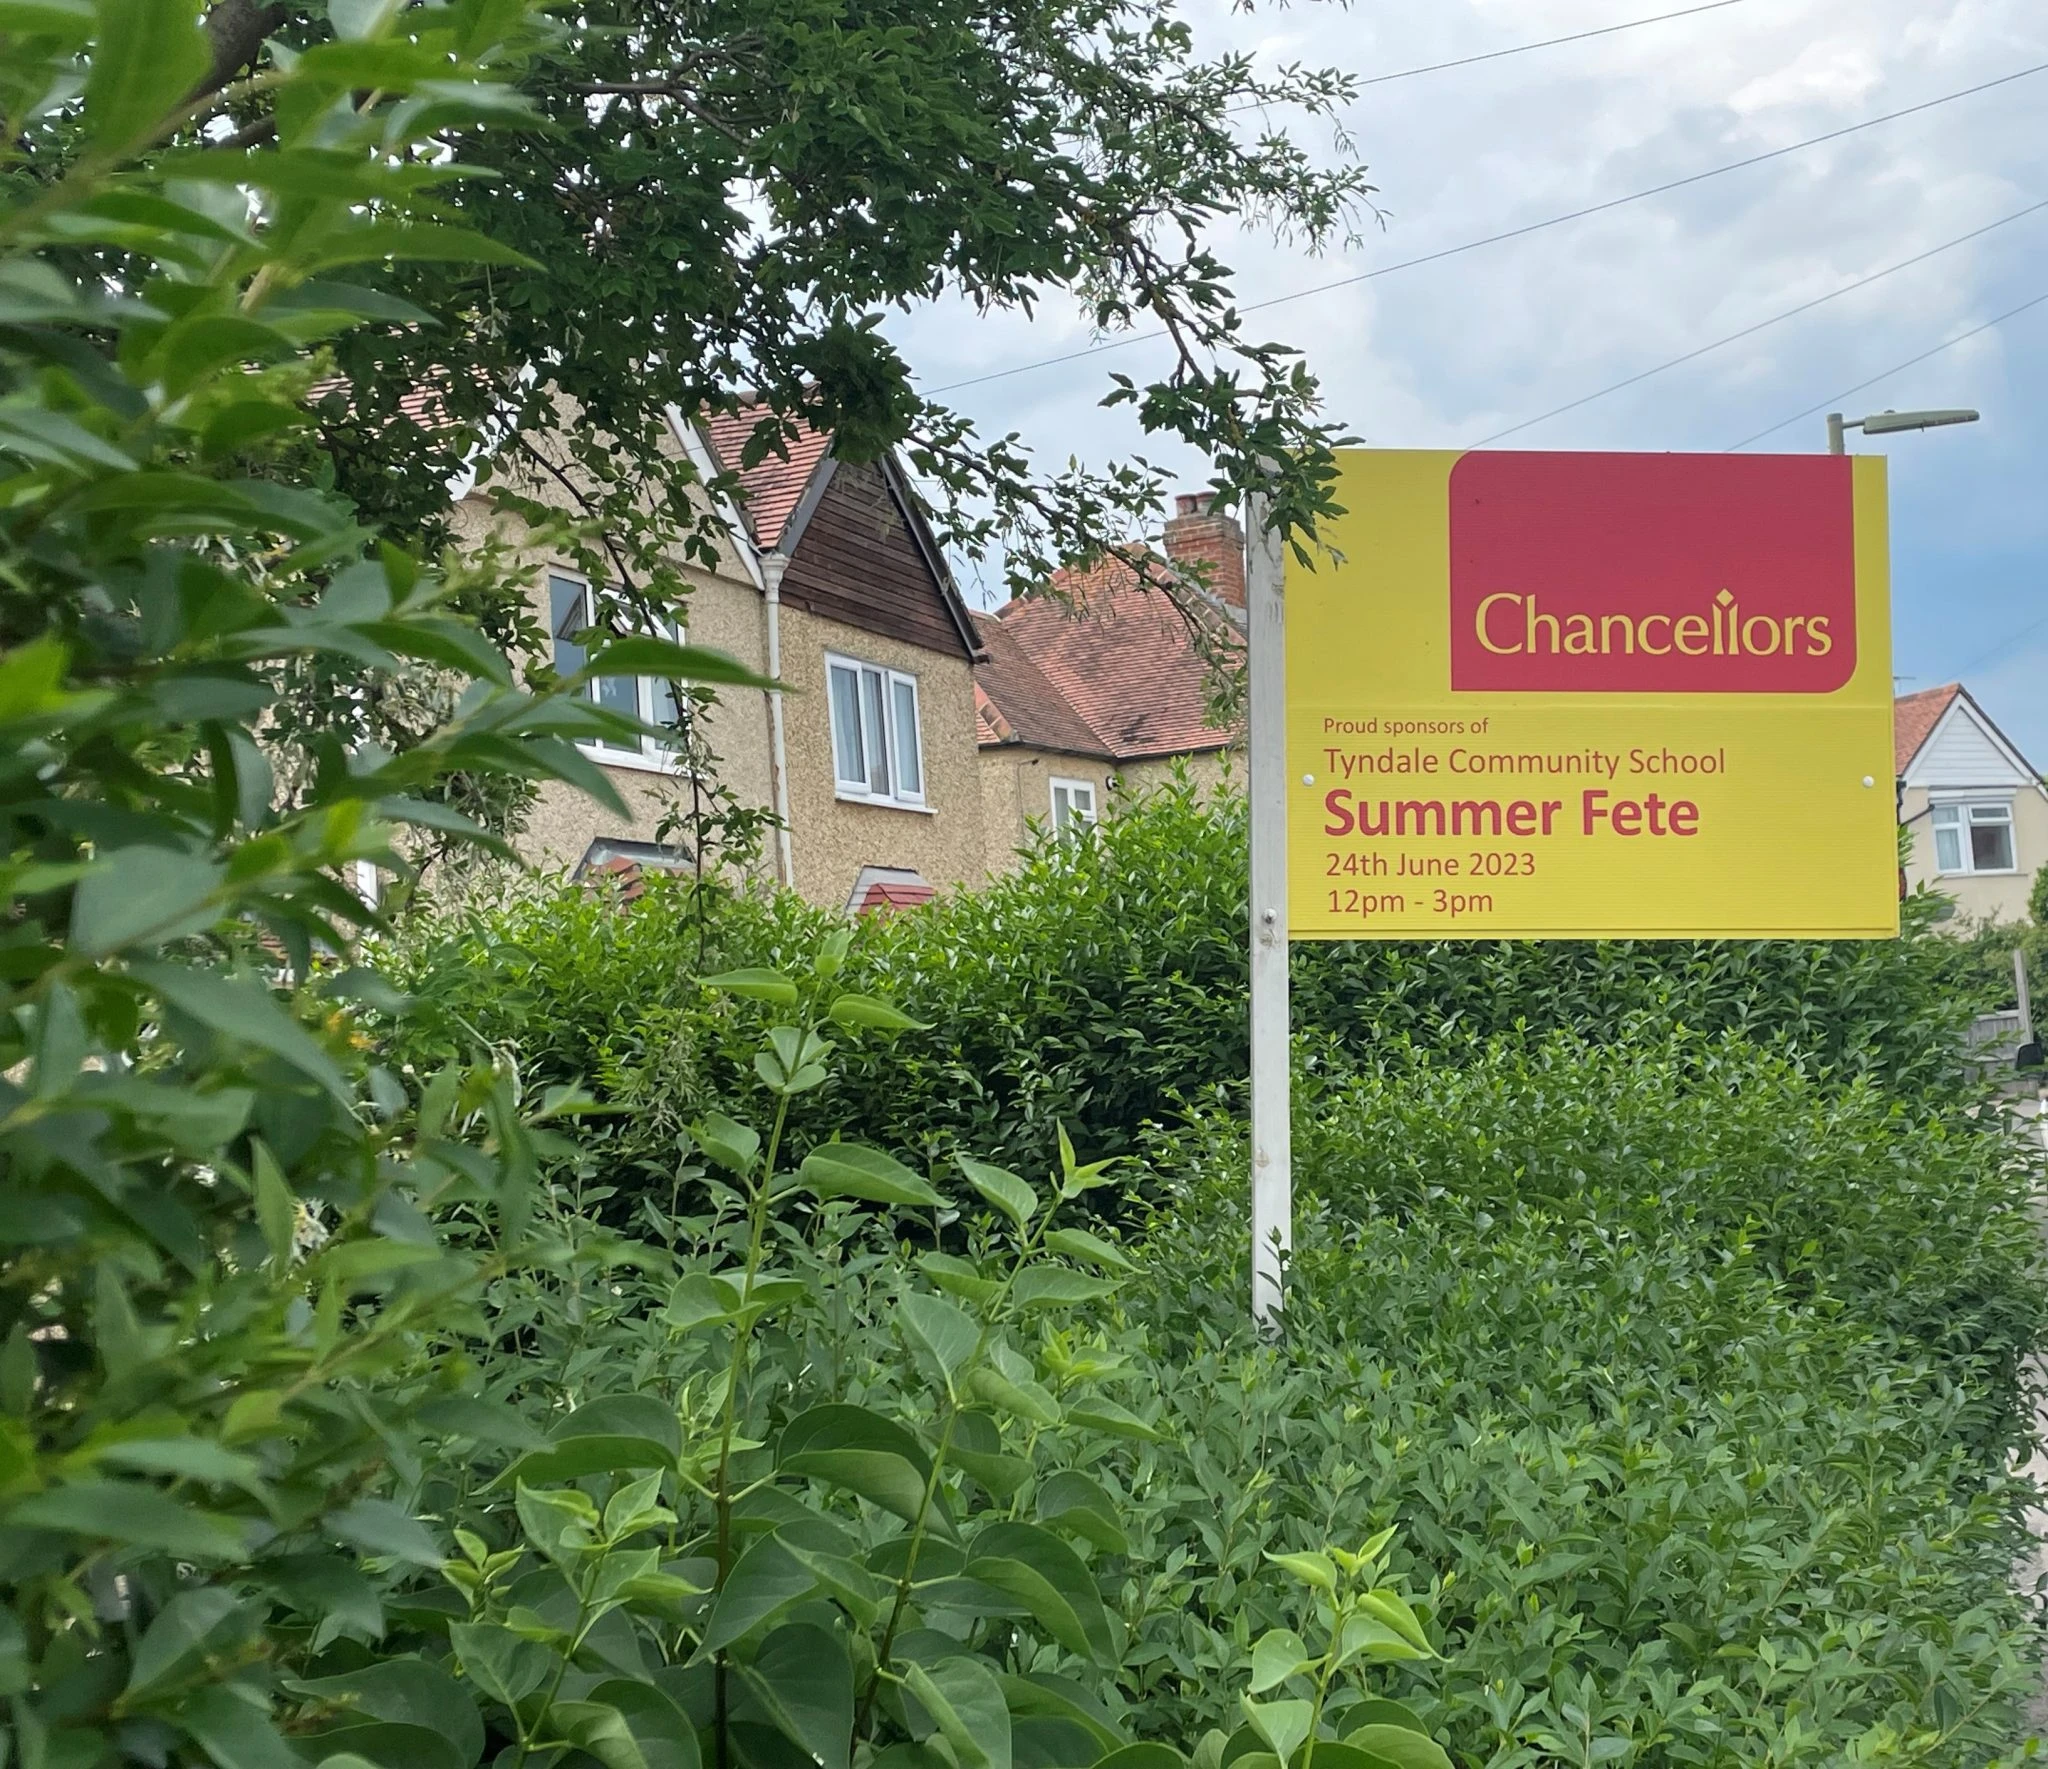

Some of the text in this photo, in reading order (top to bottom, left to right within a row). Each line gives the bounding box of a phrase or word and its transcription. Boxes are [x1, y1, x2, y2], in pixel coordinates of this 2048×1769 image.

[1475, 588, 1833, 657] Chancellors
[1323, 717, 1490, 737] Proud sponsors of
[1323, 747, 1726, 780] Tyndale Community School
[1324, 788, 1700, 837] Summer Fete
[1325, 852, 1537, 877] 24th June 2023
[1327, 889, 1406, 919] 12pm
[1432, 889, 1494, 919] 3pm
